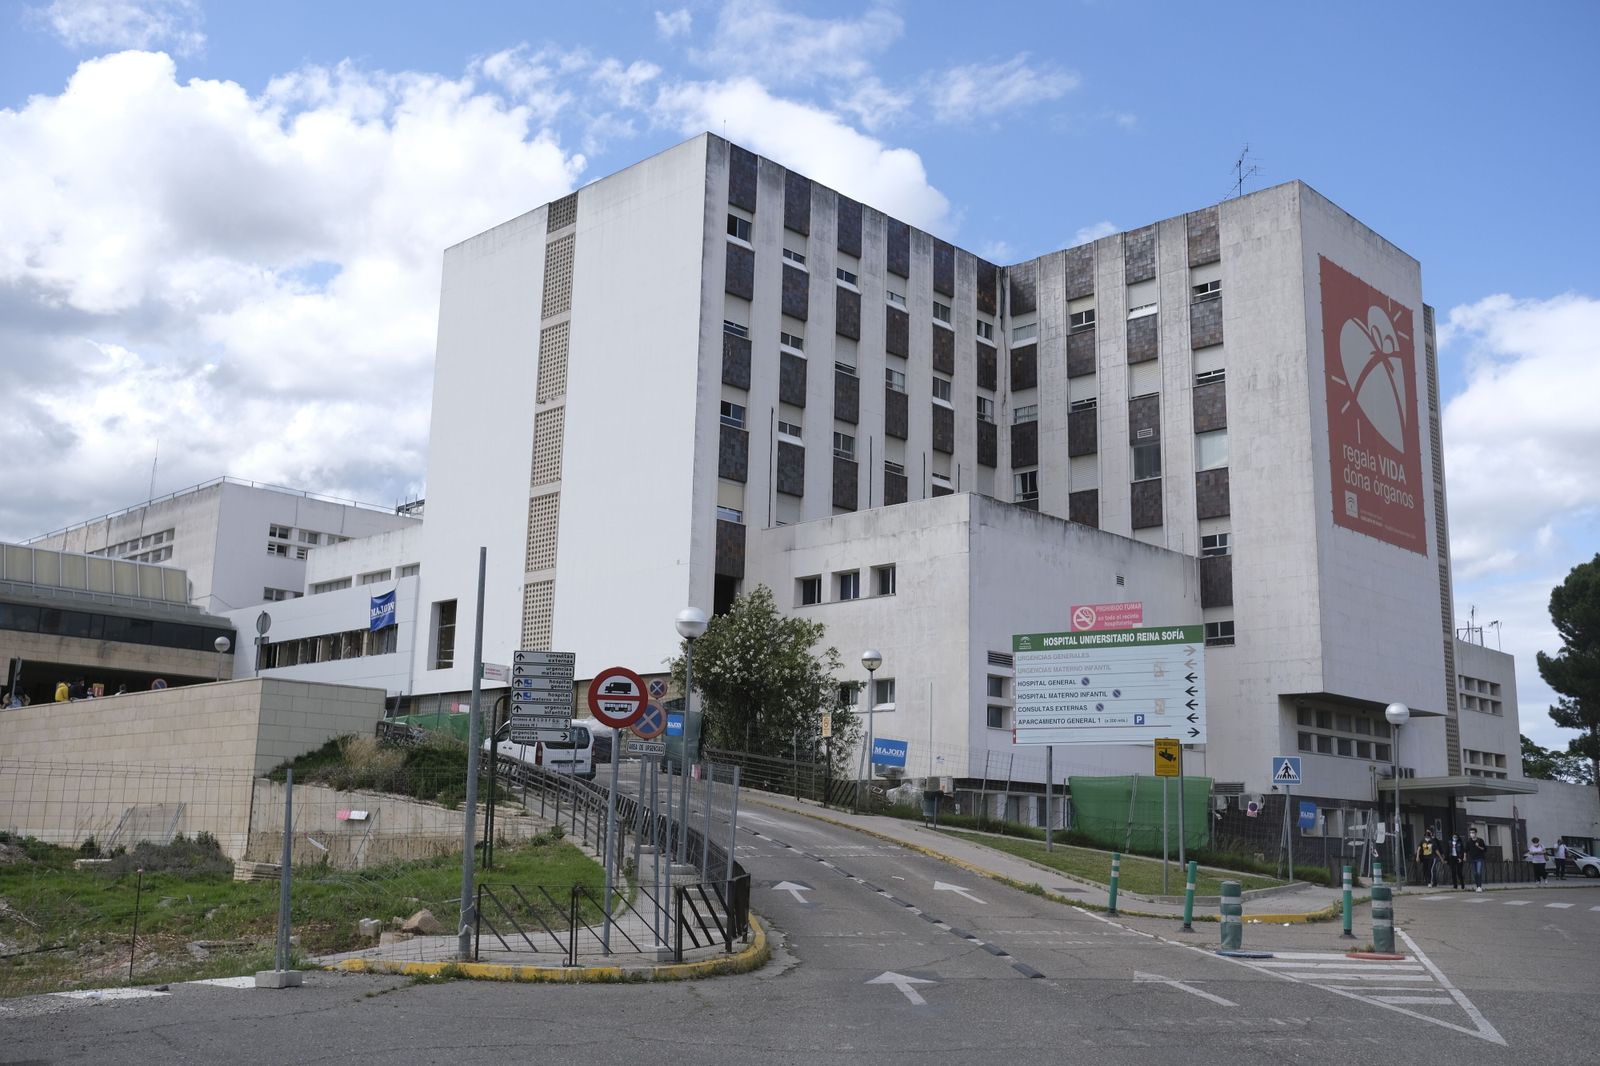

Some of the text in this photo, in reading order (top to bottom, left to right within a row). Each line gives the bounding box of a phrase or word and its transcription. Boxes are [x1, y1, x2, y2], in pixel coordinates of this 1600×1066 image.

[1343, 443, 1407, 485] regala VIDA
[1343, 464, 1414, 509] dona órganos
[1043, 636, 1078, 647] HOSPITAL
[1080, 633, 1135, 645] UNIVERSITARIO
[1136, 631, 1160, 642] REINA
[1161, 628, 1185, 640] SOFÍA
[1048, 691, 1079, 699] MATERNO
[1080, 690, 1108, 698] INFANTIL
[1017, 705, 1054, 713] CONSULTAS
